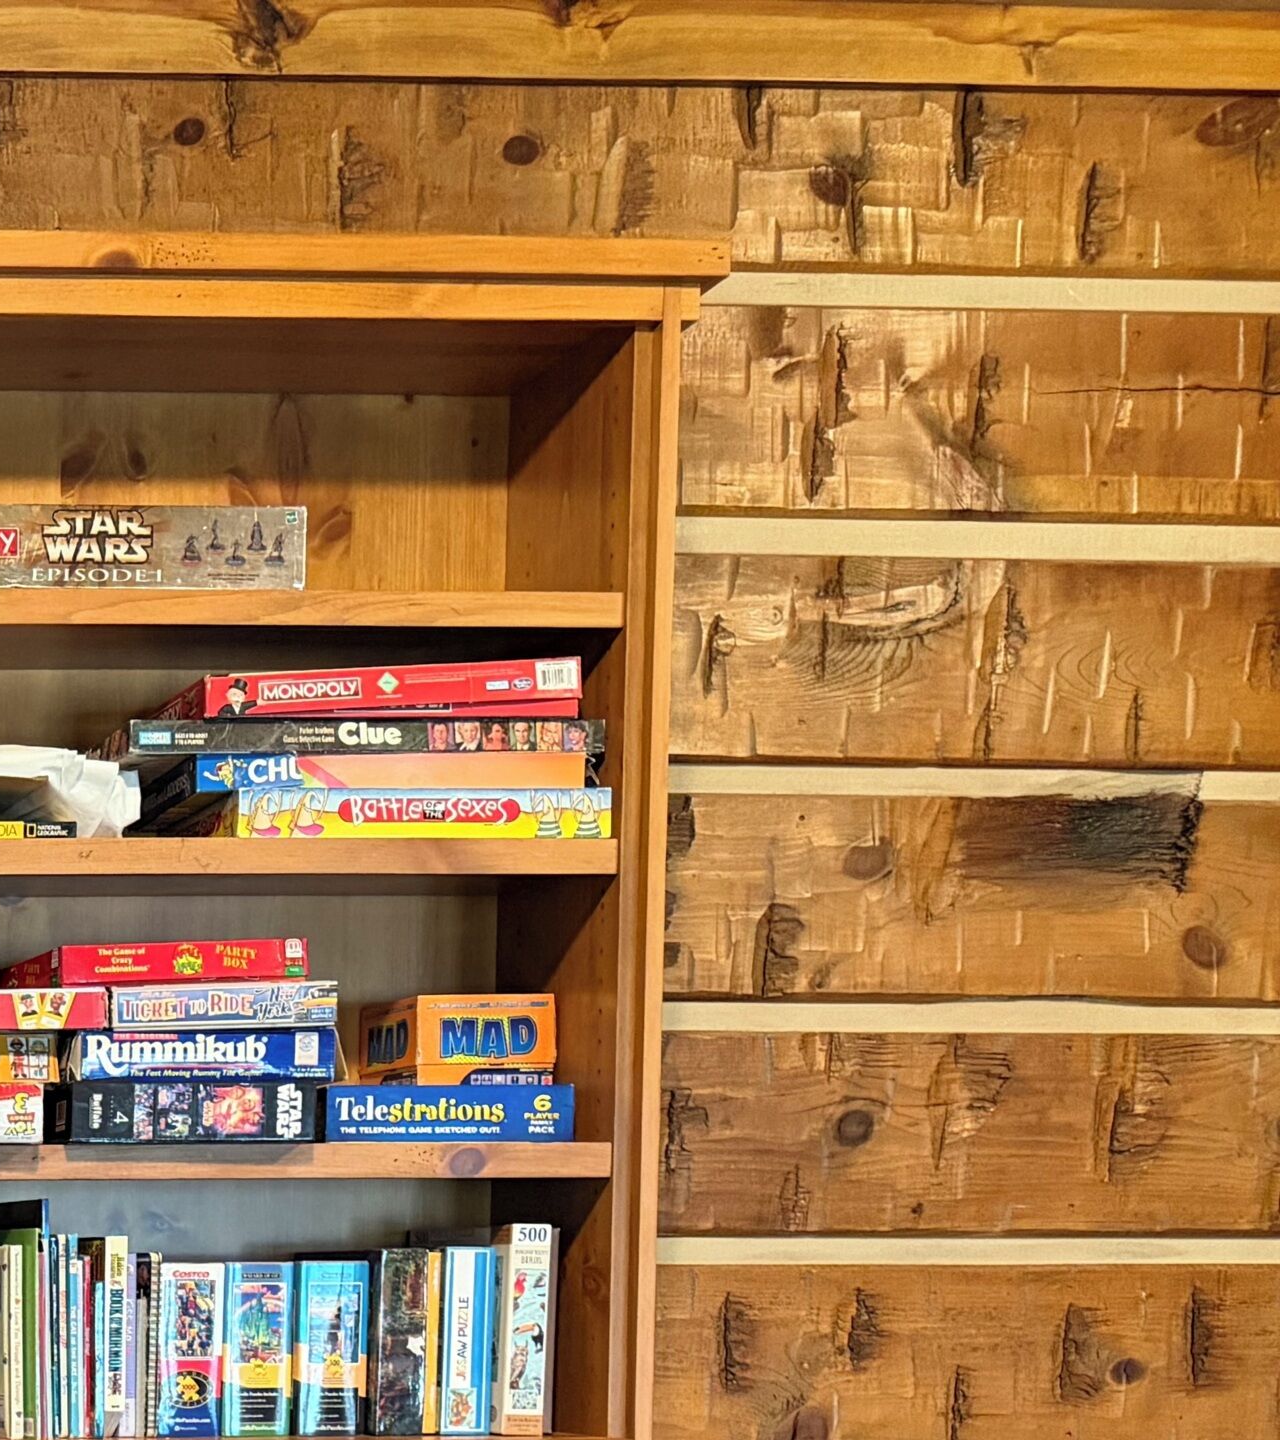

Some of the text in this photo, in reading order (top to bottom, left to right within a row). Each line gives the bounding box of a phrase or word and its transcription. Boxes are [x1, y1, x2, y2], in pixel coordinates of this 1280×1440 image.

[42, 510, 148, 536] STAR
[43, 535, 153, 564] WARS
[32, 567, 151, 583] EPISODE
[262, 679, 360, 701] MONOPOLY
[338, 721, 402, 746] Clue
[111, 957, 133, 965] Crazy
[215, 944, 257, 959] PARTY
[223, 956, 248, 970] BOX
[122, 991, 255, 1021] TICKET RIDE
[440, 1016, 537, 1059] MAD
[86, 1035, 265, 1077] Rummikub
[276, 1084, 289, 1139] WARS
[287, 1083, 302, 1136] STAR
[335, 1096, 505, 1122] Telestrations
[533, 1095, 552, 1111] 6
[524, 1112, 559, 1120] PLAYER
[528, 1126, 555, 1134] PACK
[518, 1227, 547, 1242] 500
[172, 1270, 209, 1278] COSTCO
[109, 1288, 124, 1373] BOOK MORMON
